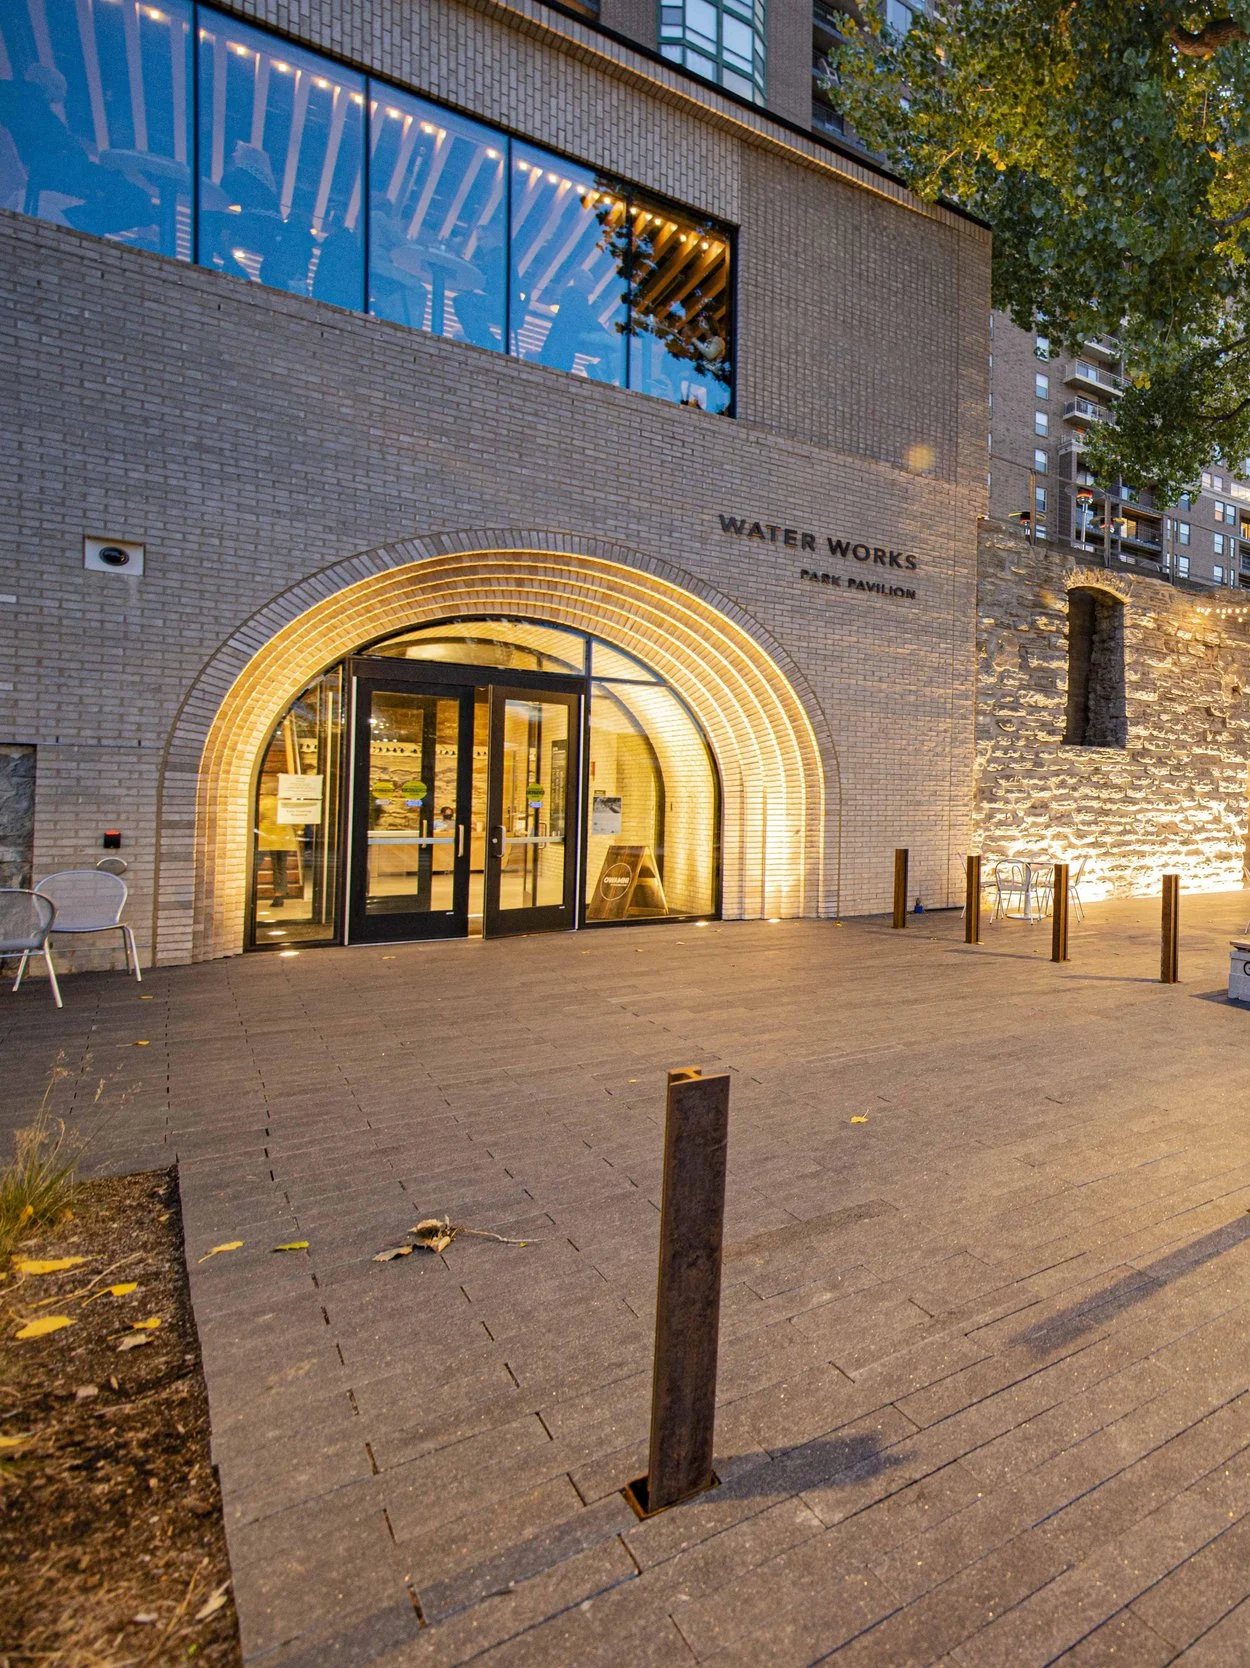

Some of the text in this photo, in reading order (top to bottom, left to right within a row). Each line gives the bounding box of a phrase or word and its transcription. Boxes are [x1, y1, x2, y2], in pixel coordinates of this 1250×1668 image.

[718, 513, 918, 570] WATER WORKS
[800, 569, 917, 600] PARK PAVILION
